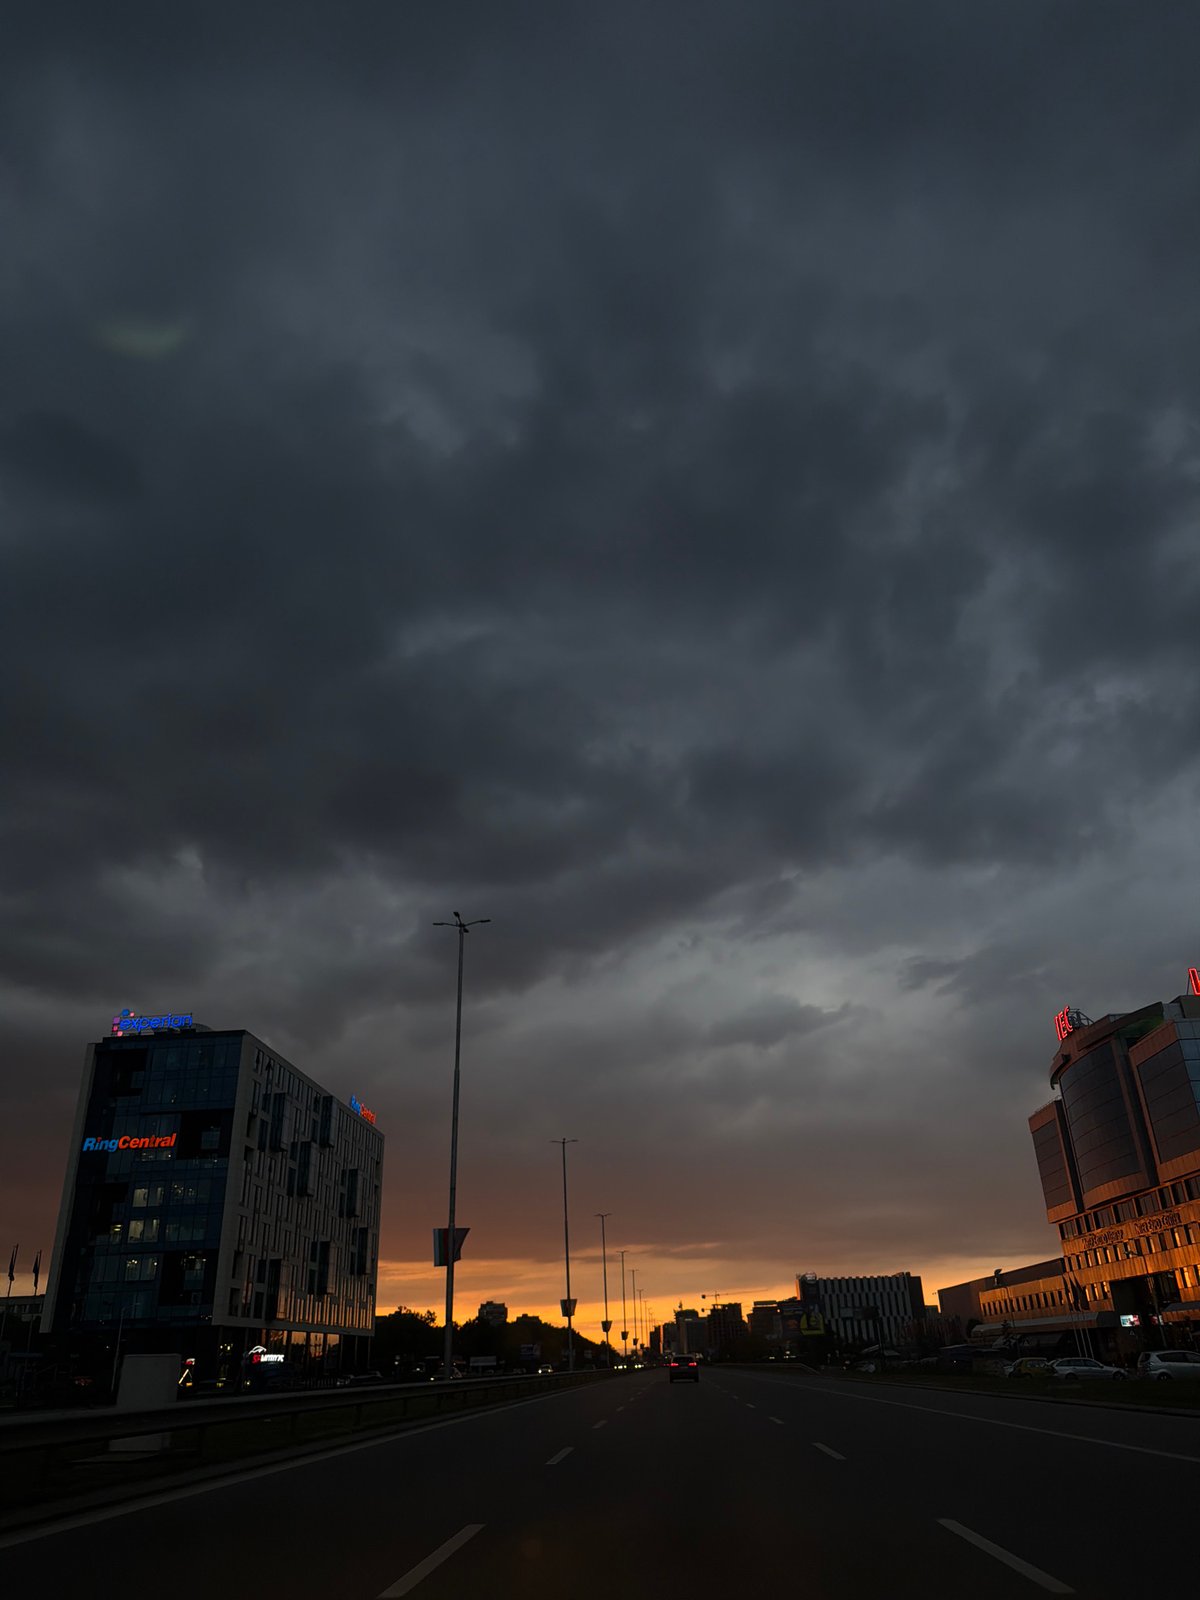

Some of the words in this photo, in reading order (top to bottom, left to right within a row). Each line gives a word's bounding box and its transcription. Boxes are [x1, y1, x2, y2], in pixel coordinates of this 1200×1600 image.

[120, 1013, 193, 1032] experian
[1054, 1005, 1074, 1041] IEC
[82, 1132, 177, 1152] RingCentral
